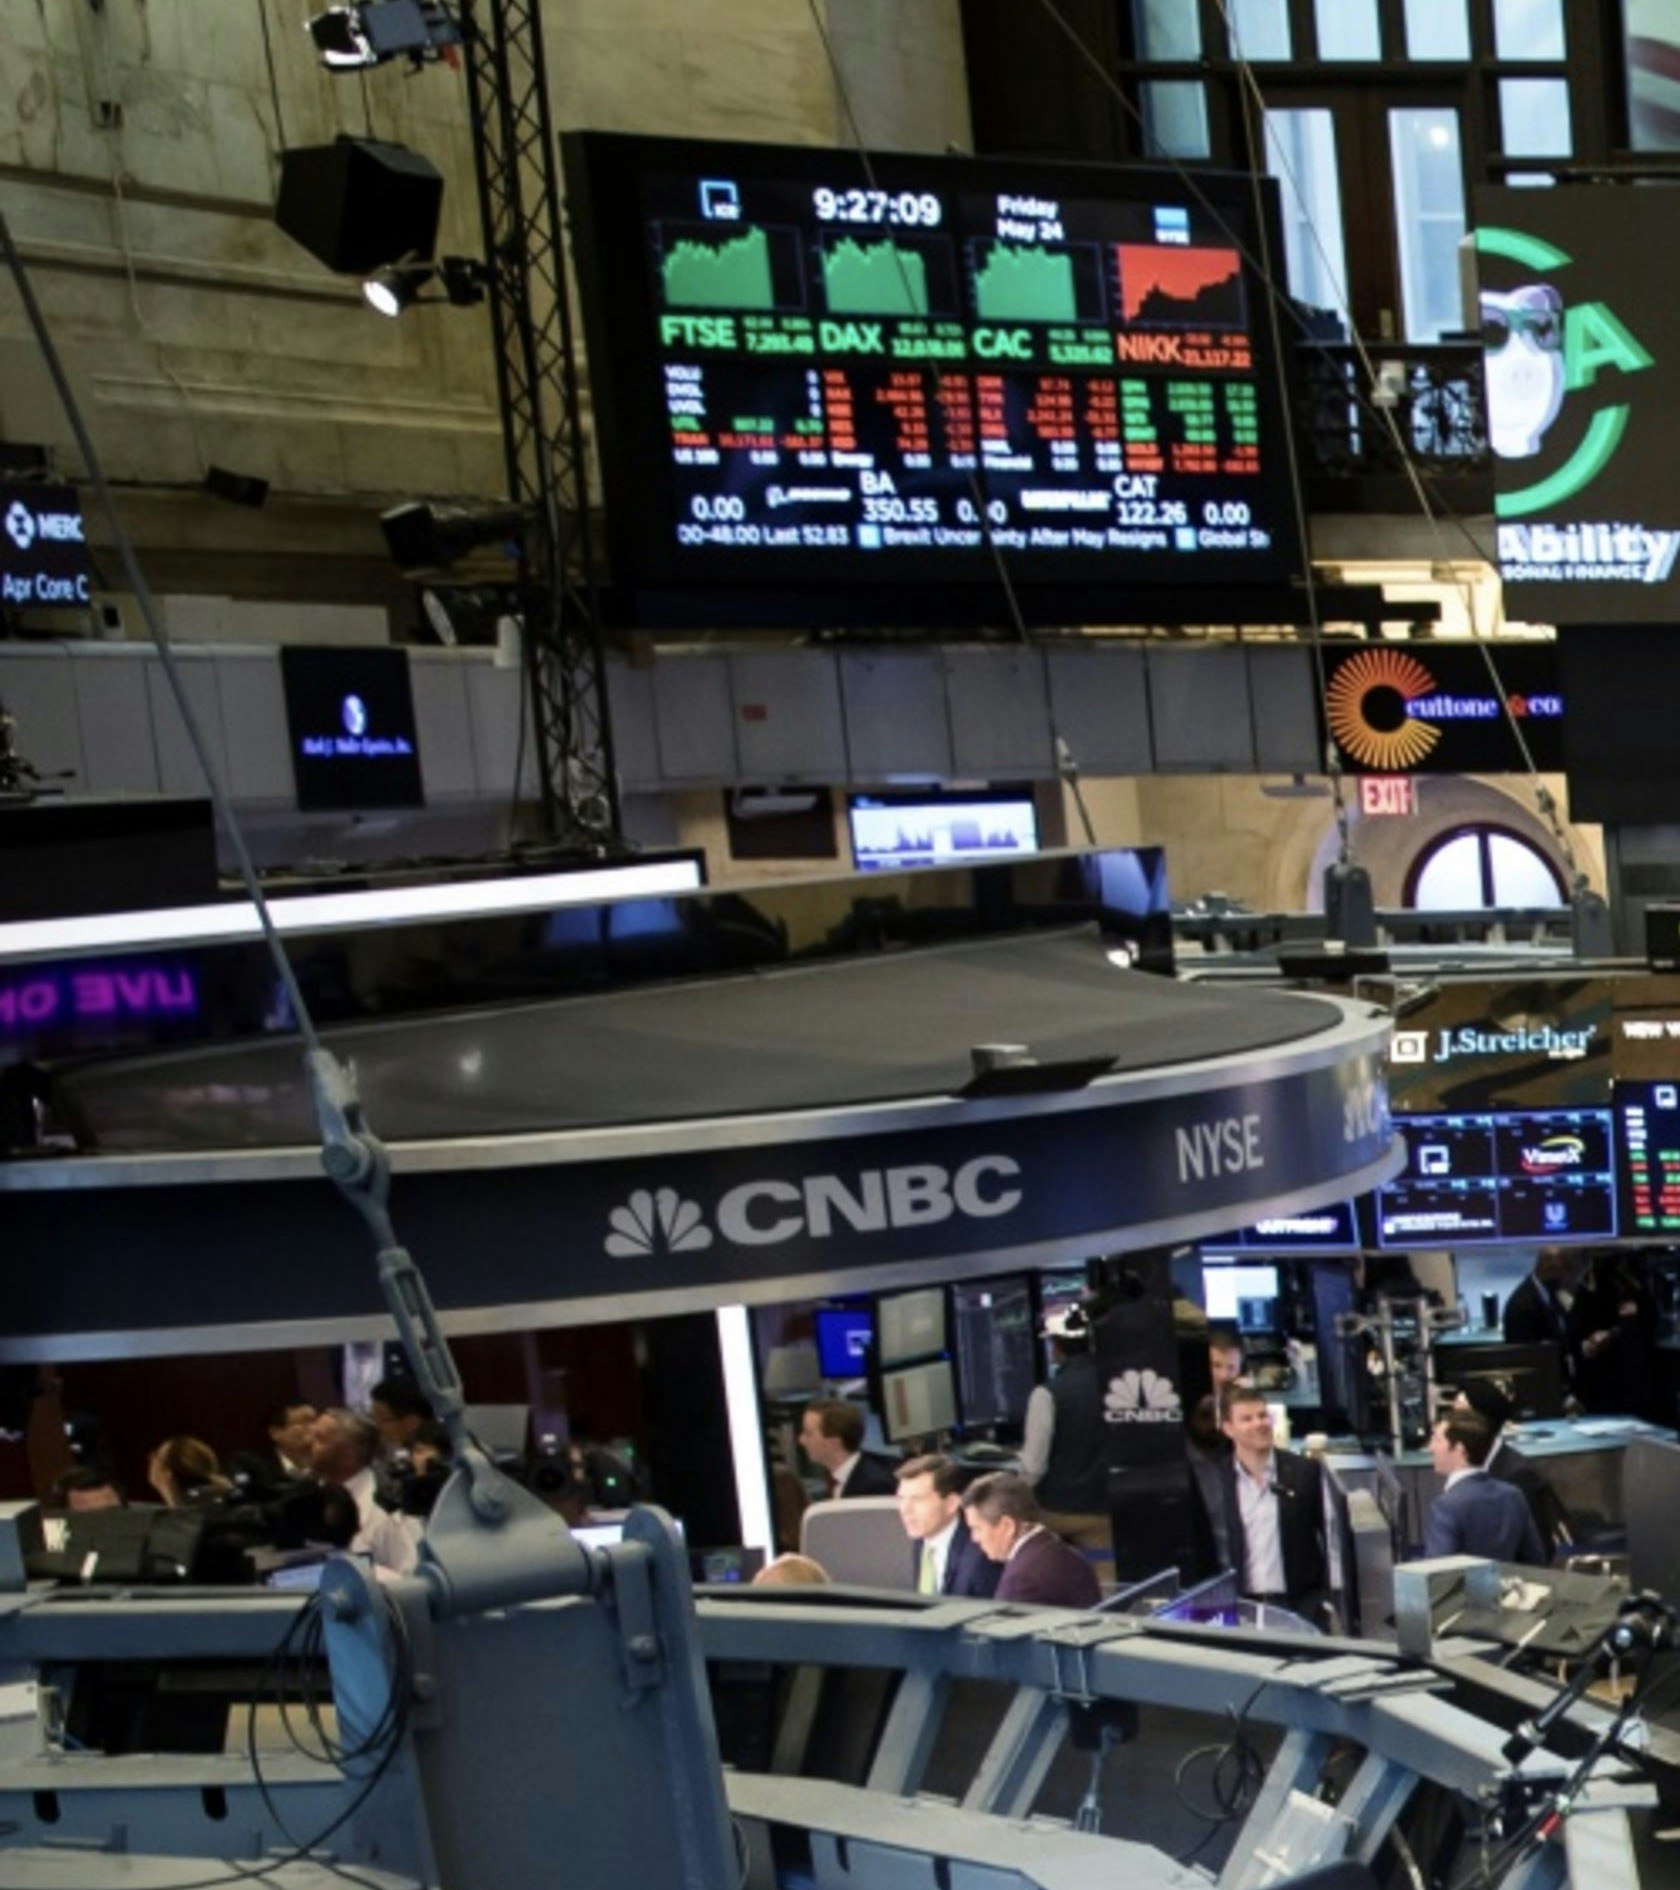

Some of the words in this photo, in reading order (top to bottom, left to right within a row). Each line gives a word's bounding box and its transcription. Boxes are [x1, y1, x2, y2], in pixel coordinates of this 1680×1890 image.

[814, 189, 941, 226] 9:27:09
[997, 194, 1058, 219] Friday
[997, 219, 1035, 242] May
[1038, 221, 1064, 240] 24
[660, 316, 736, 348] FTSE
[820, 322, 883, 353] DAX
[973, 328, 1033, 358] CAC
[1118, 333, 1183, 362] NIKK
[860, 470, 896, 495] BA
[1115, 475, 1158, 498] CAT
[692, 497, 745, 521] 0.00
[863, 498, 939, 522] 350.55
[1117, 501, 1188, 526] 122.26
[1204, 502, 1250, 526] 0.00
[1030, 528, 1071, 547] After
[3, 576, 31, 603] Apr
[36, 573, 75, 601] Core
[1404, 694, 1499, 718] cuttone
[1362, 777, 1411, 815] EXIT
[1623, 1020, 1662, 1040] NEW
[1433, 1024, 1596, 1063] J.Streicher
[1176, 1115, 1265, 1182] NYSE
[716, 1154, 1023, 1247] CNBC
[1104, 1408, 1184, 1424] CNBC
